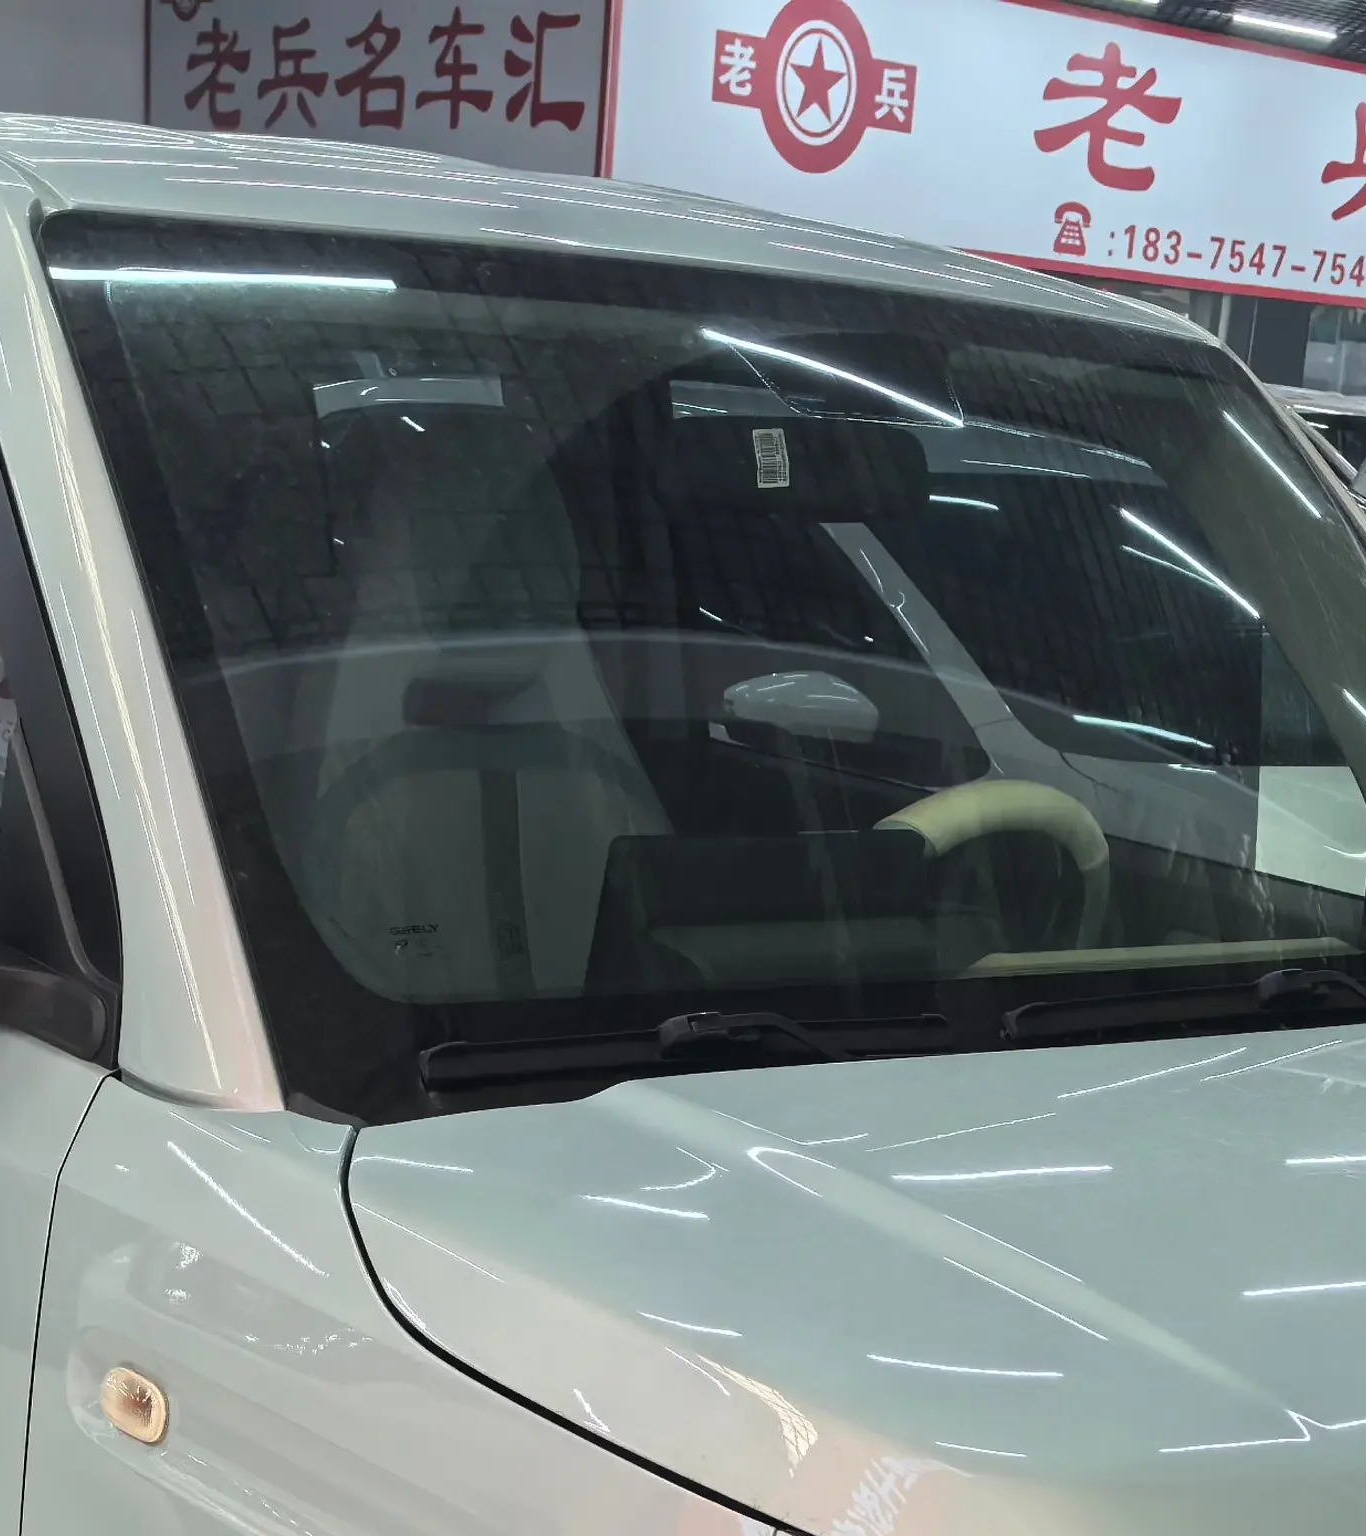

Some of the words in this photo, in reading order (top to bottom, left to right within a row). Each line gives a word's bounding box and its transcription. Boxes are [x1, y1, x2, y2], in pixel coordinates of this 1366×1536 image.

[184, 6, 586, 131] 老兵名车汇
[718, 38, 757, 97] 老
[874, 68, 909, 123] 兵
[1033, 41, 1183, 192] 老
